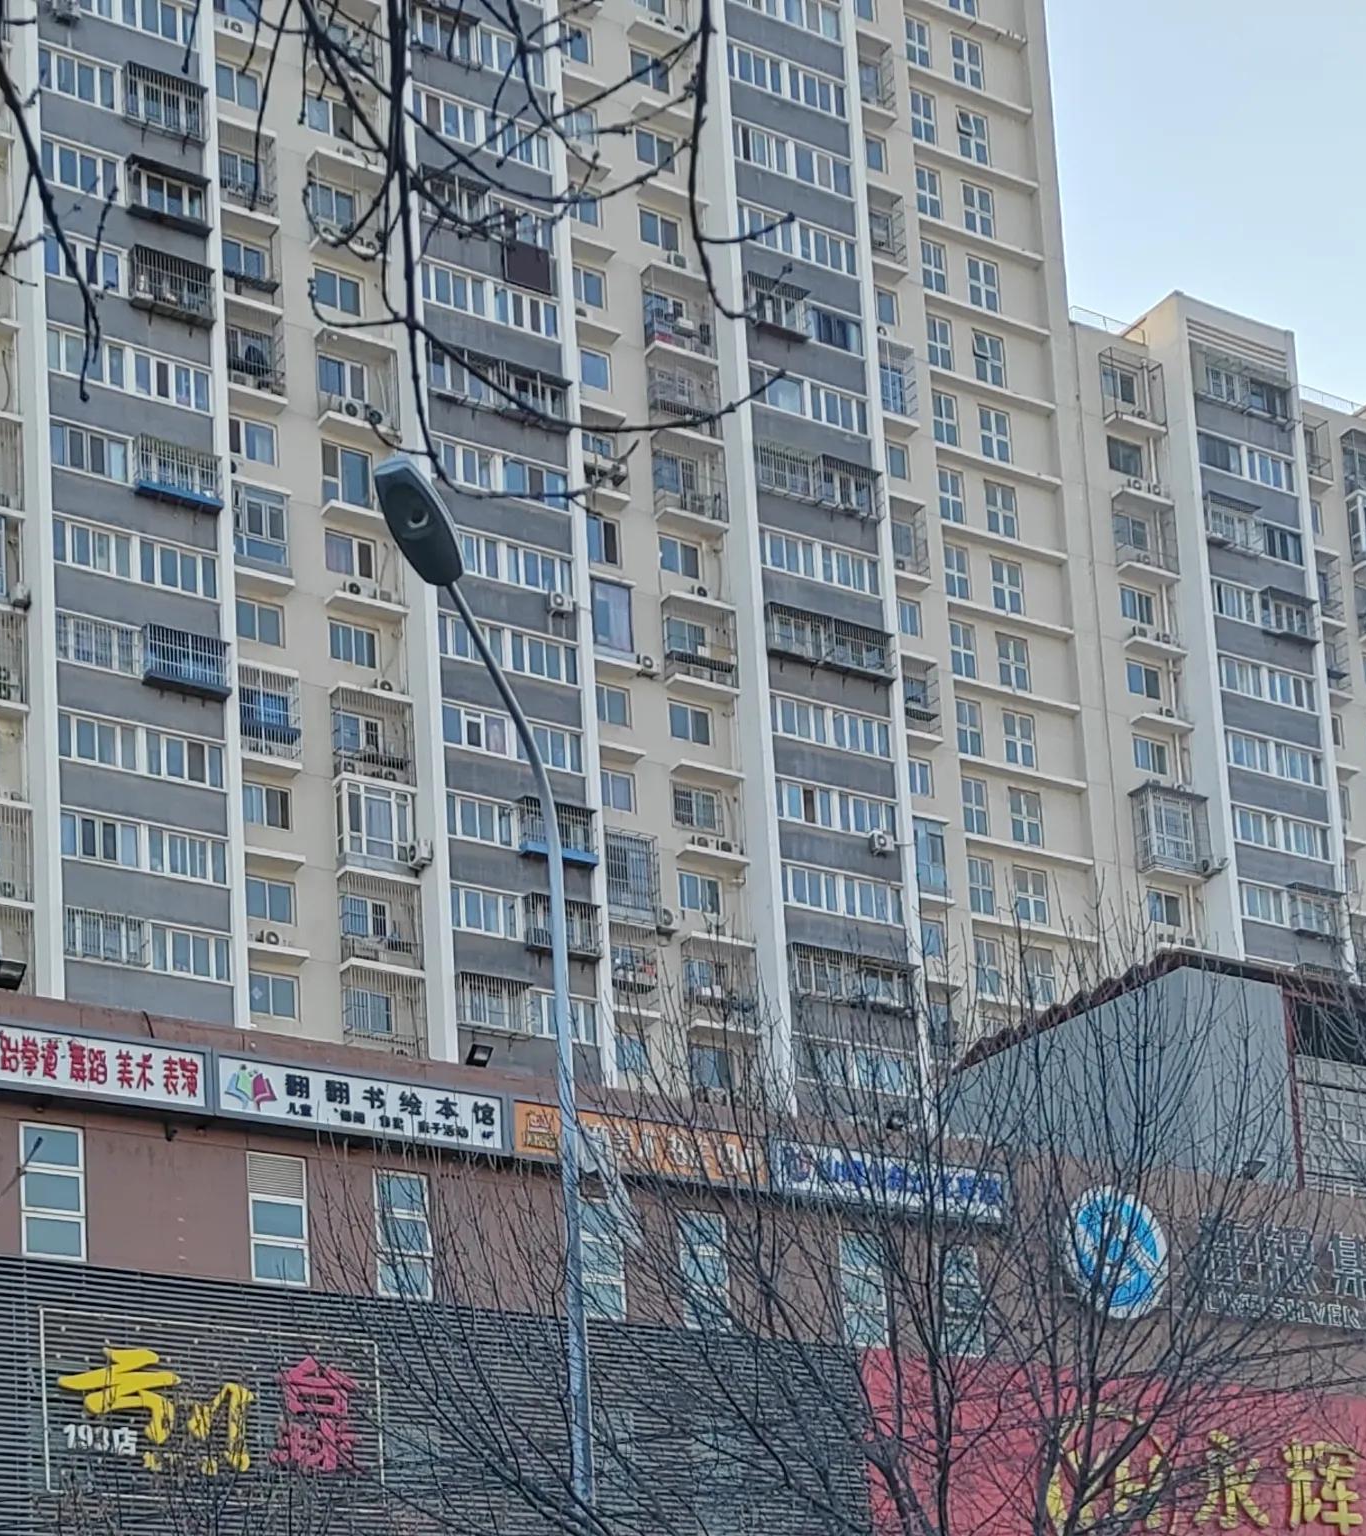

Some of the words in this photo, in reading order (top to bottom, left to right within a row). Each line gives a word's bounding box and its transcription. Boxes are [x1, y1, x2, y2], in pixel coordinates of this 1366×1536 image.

[115, 1049, 155, 1092] 美术
[162, 1056, 199, 1098] 表演
[285, 1074, 495, 1126] 翻翻书绘本馆
